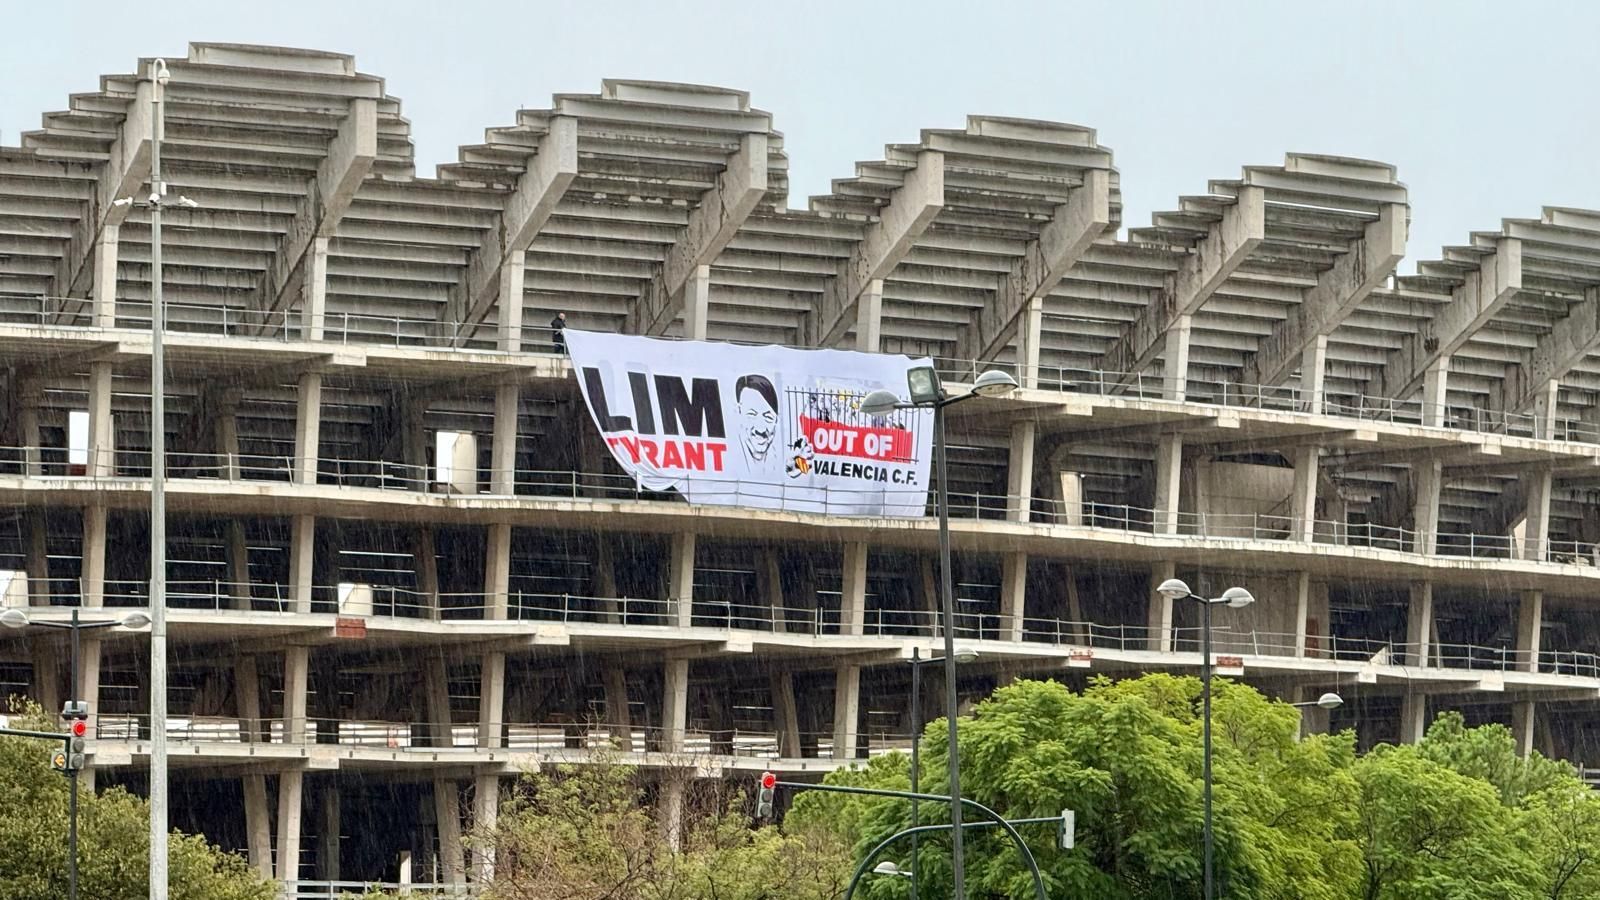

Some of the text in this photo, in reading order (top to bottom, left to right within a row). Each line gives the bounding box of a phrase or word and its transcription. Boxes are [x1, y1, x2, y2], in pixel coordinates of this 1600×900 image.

[582, 366, 726, 438] LIM
[813, 427, 894, 457] OUT OF
[814, 460, 918, 486] VALENCIA C.F.
